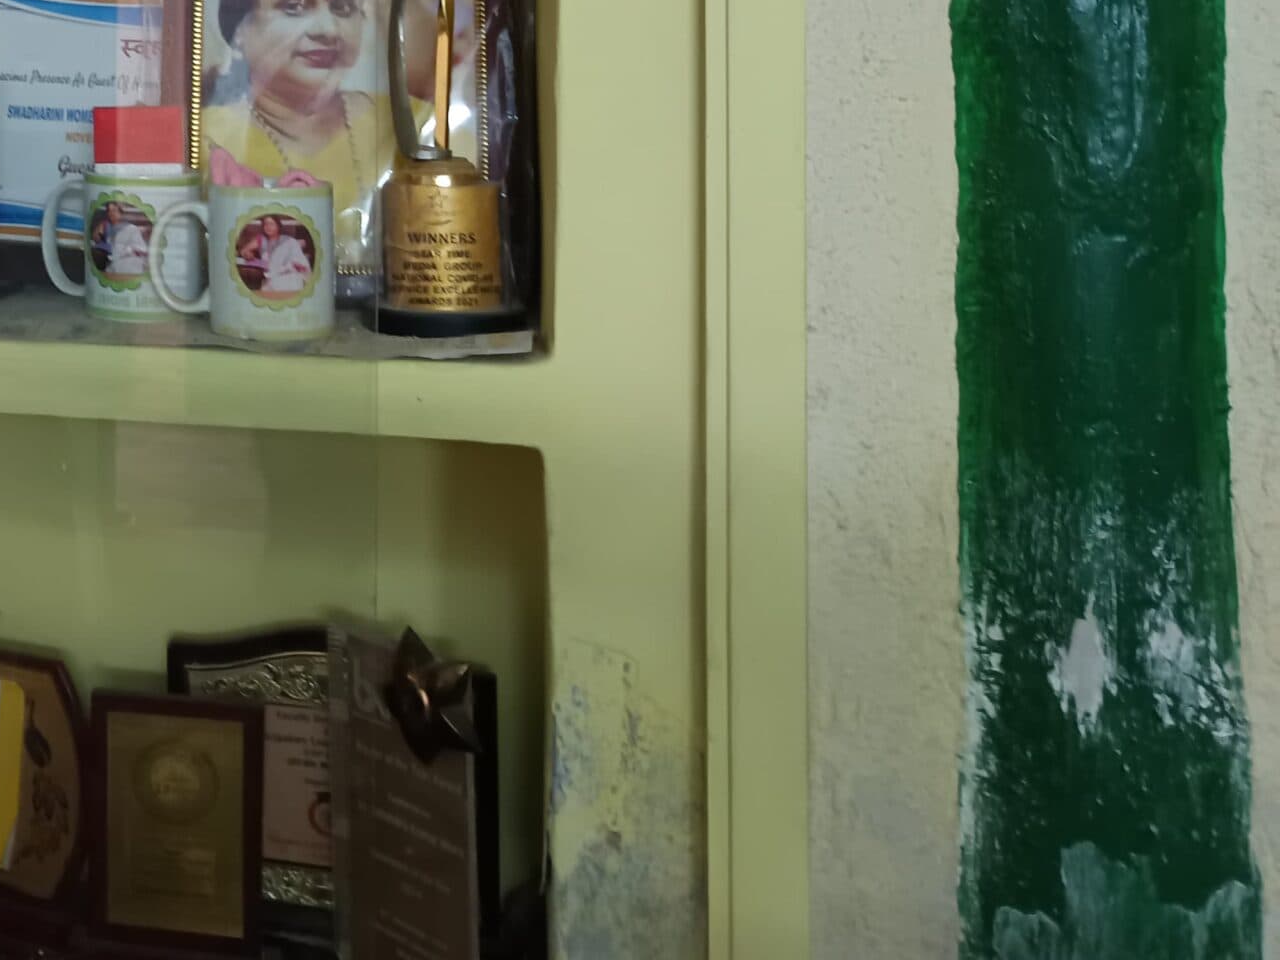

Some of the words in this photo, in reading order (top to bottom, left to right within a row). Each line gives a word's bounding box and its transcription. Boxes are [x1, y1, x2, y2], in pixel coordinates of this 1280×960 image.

[7, 104, 64, 121] SWADHARINI
[66, 107, 94, 123] WOME
[65, 131, 93, 144] NOVE
[407, 232, 477, 244] WINNERS
